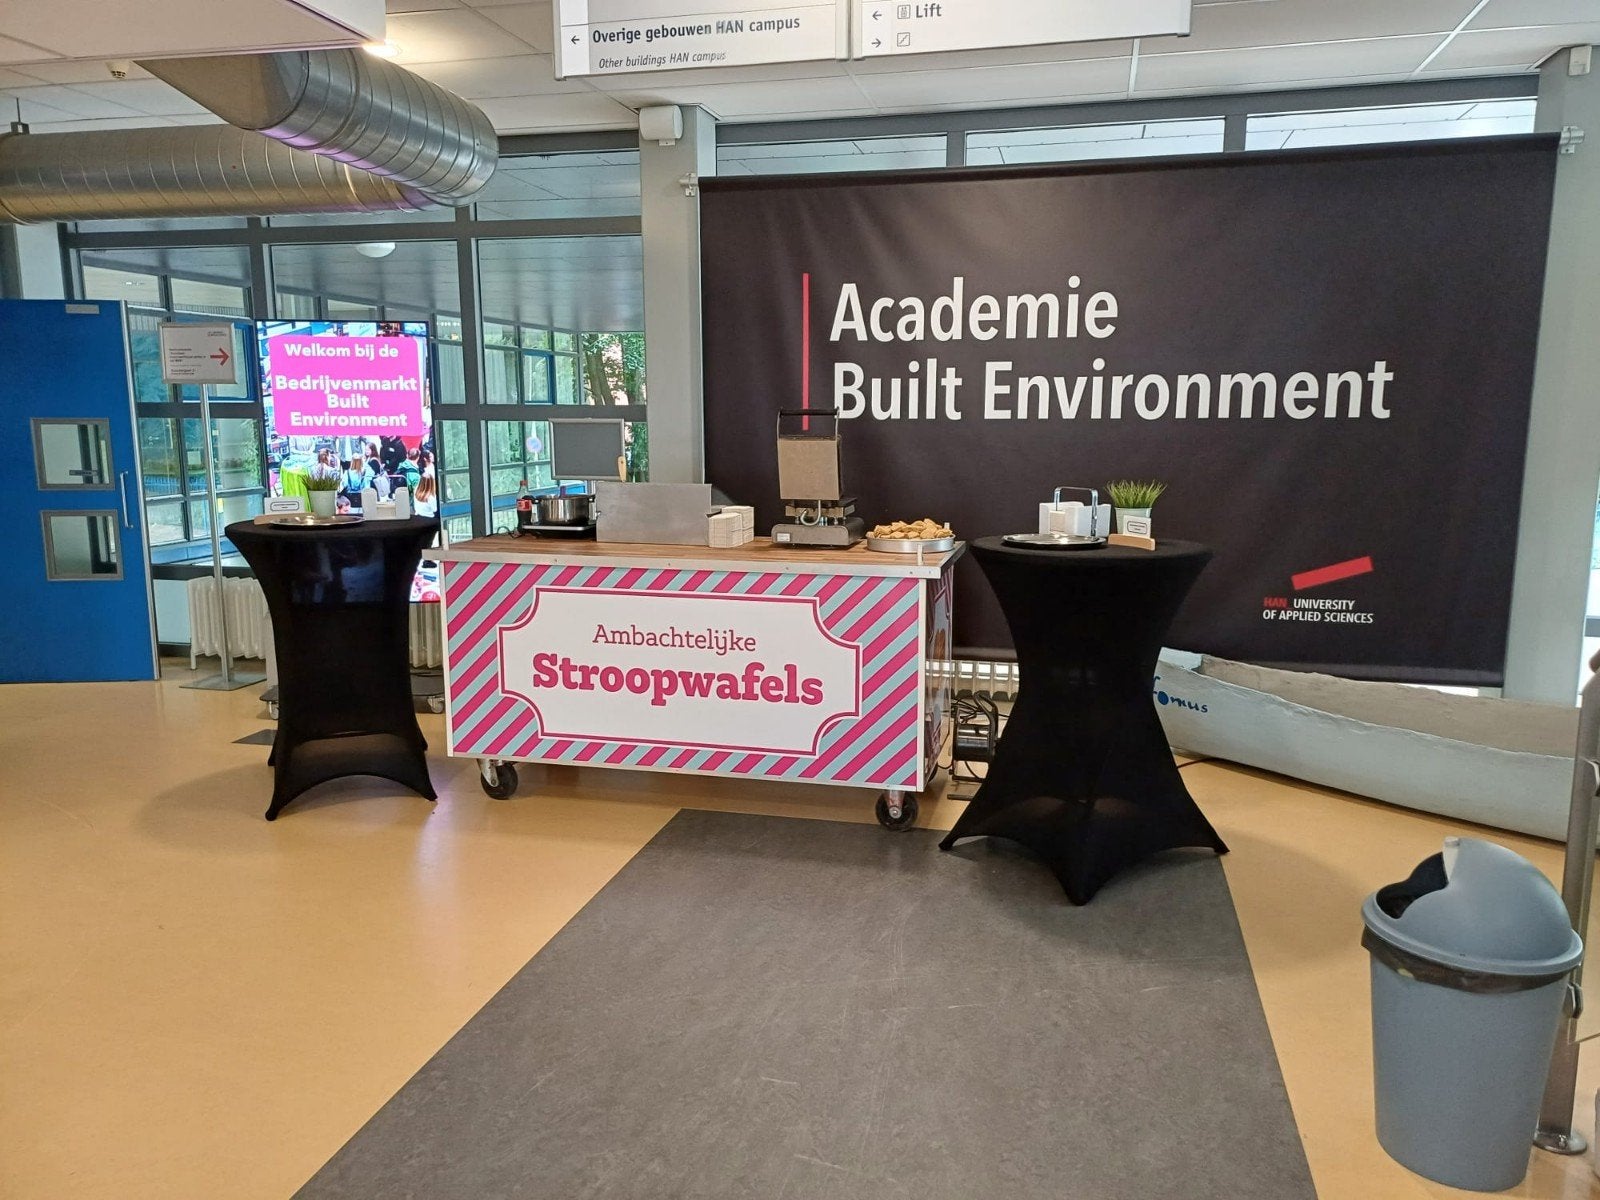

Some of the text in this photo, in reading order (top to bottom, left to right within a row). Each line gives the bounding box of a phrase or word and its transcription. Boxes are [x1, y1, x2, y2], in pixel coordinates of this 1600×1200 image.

[915, 3, 943, 18] Lift
[592, 16, 801, 44] Overige gebouwen HAN campus
[598, 51, 726, 69] Other buildings HAN campus
[829, 275, 1119, 342] Academie
[284, 343, 399, 361] Welkom bij de
[275, 375, 418, 394] Bedrijvenmarkt
[833, 357, 1394, 421] Built Environment
[326, 393, 370, 409] Built
[290, 411, 408, 427] Environment
[1293, 598, 1355, 610] UNIVERSITY
[1262, 609, 1374, 624] OF APPLIED SCIENCES
[592, 624, 757, 656] Ambachtelijke
[532, 652, 824, 706] Stroopwafels
